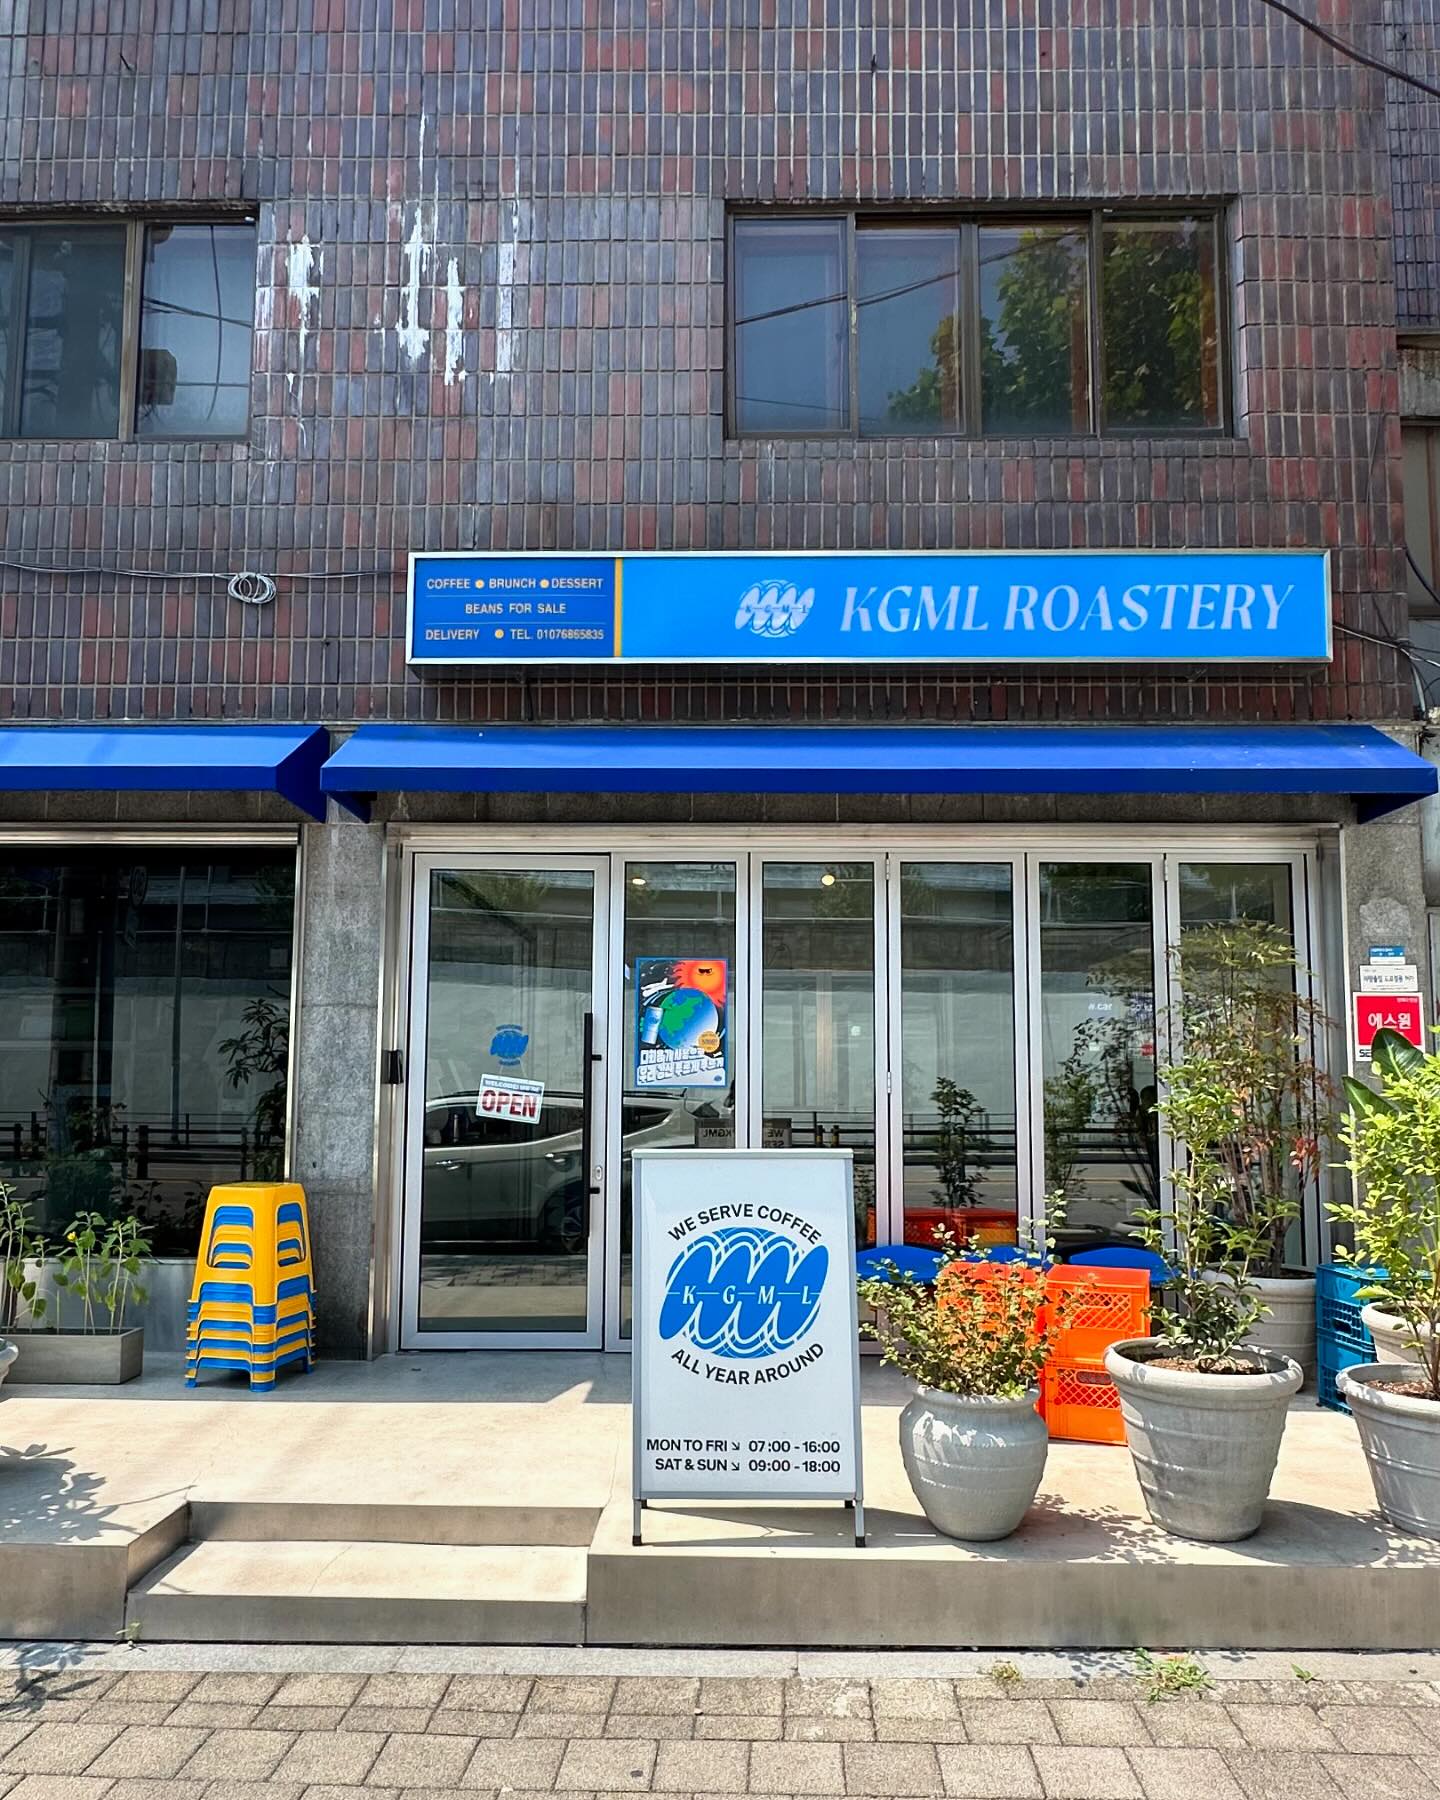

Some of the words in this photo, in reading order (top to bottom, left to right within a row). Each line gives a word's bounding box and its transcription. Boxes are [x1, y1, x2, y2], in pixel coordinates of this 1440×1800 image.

[426, 578, 471, 589] COFFEE
[488, 578, 536, 589] BRUNCH
[551, 578, 604, 589] DESSERT
[465, 603, 504, 614] BEANS
[509, 603, 532, 614] FOR
[537, 603, 567, 614] SALE
[840, 585, 989, 632] KGML
[1003, 584, 1295, 633] ROASTERY
[425, 629, 480, 640] DELIVERY
[1368, 1012, 1412, 1030] 에스원
[481, 1089, 538, 1118] OPEN
[667, 1216, 697, 1241] WE
[697, 1203, 754, 1226] SERVE
[757, 1204, 822, 1245] COFFEE
[671, 1348, 701, 1375] ALL
[705, 1363, 750, 1385] YEAR
[754, 1342, 824, 1385] AROUND
[646, 1439, 681, 1452] MON
[683, 1440, 703, 1452] TO
[706, 1440, 728, 1452] FRI
[748, 1440, 791, 1453] 07:00
[802, 1441, 841, 1454] 16:00
[655, 1458, 682, 1471] SAT
[684, 1459, 695, 1471] &
[697, 1459, 728, 1471] SUN
[748, 1459, 791, 1472] 09:00
[802, 1460, 841, 1473] 18:00
